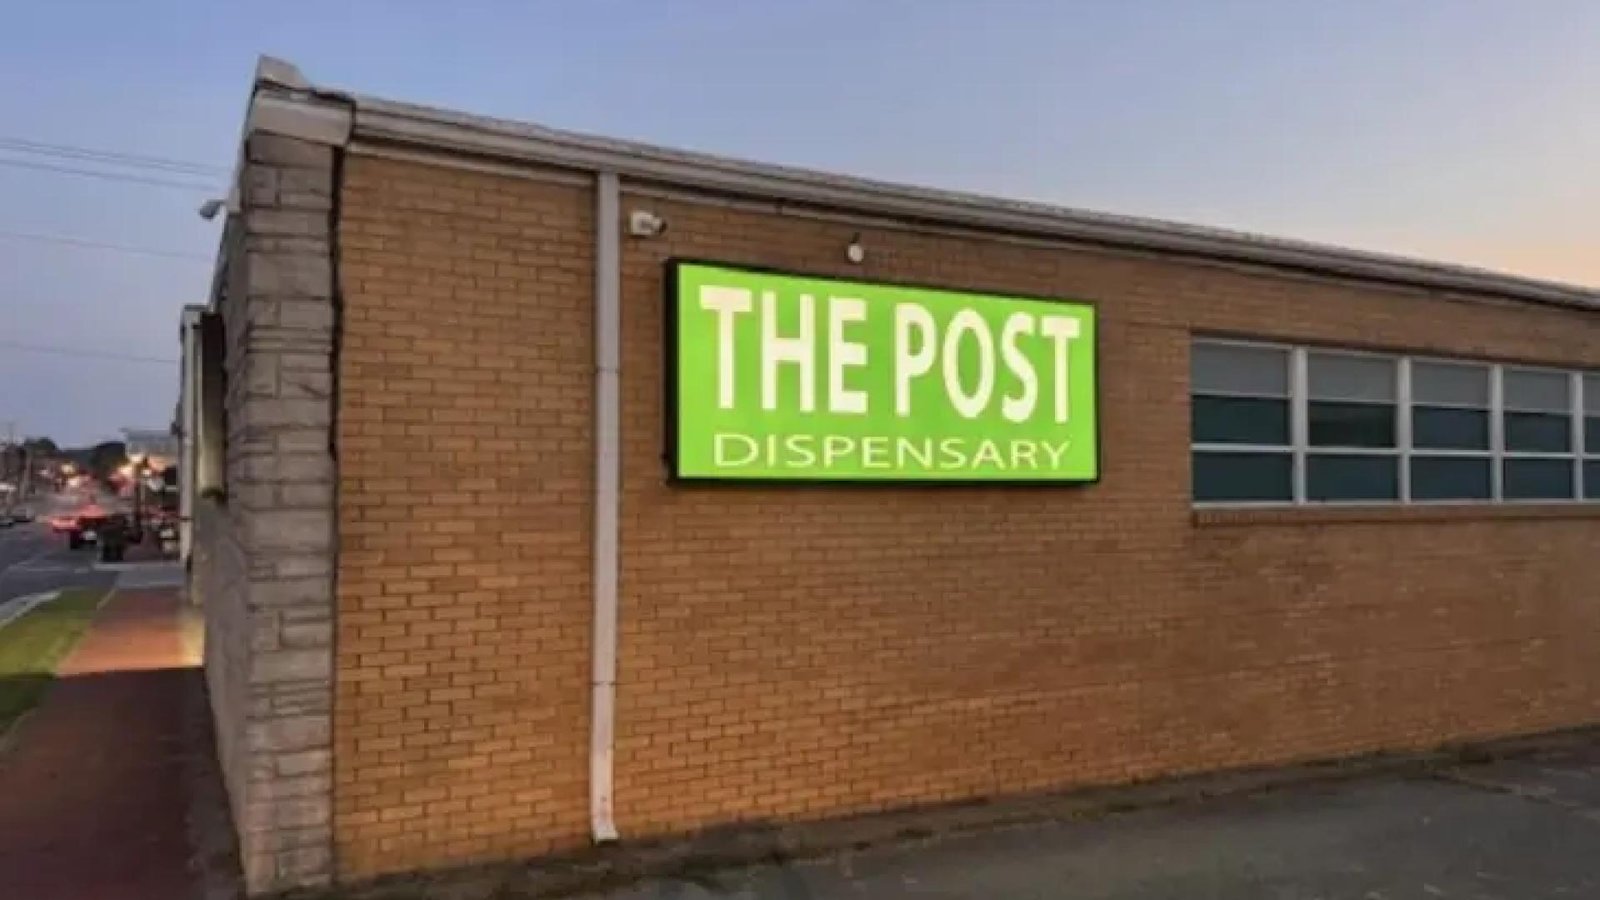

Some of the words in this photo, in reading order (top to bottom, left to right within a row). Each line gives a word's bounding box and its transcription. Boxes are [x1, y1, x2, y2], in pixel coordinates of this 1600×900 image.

[700, 285, 868, 414] THE
[896, 302, 1080, 423] POST
[713, 432, 1071, 470] DISPENSARY
